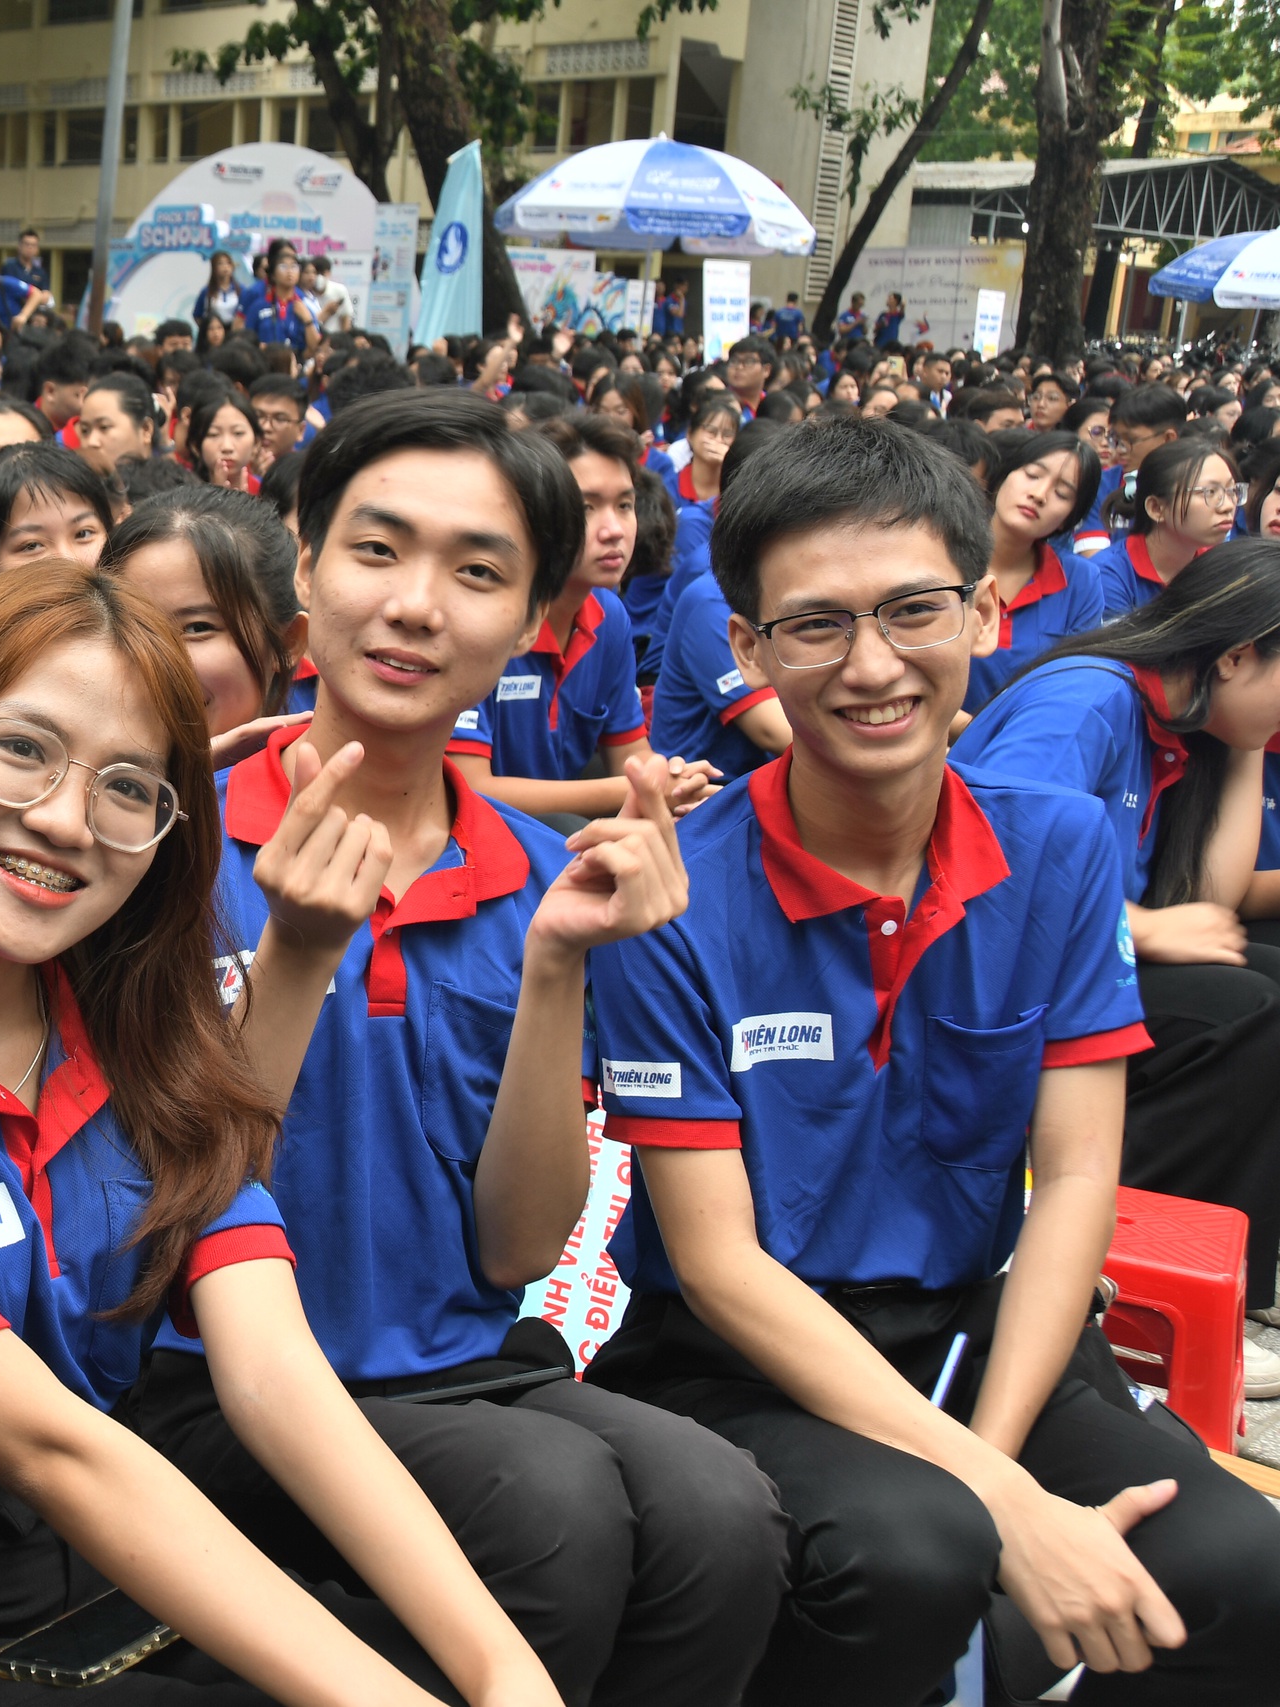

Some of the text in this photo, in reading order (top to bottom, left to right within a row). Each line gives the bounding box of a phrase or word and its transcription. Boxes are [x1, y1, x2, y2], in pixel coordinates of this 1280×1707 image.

[140, 224, 213, 249] SCHOOL
[778, 1025, 823, 1044] LONG
[613, 1068, 673, 1085] THIÊN LONG
